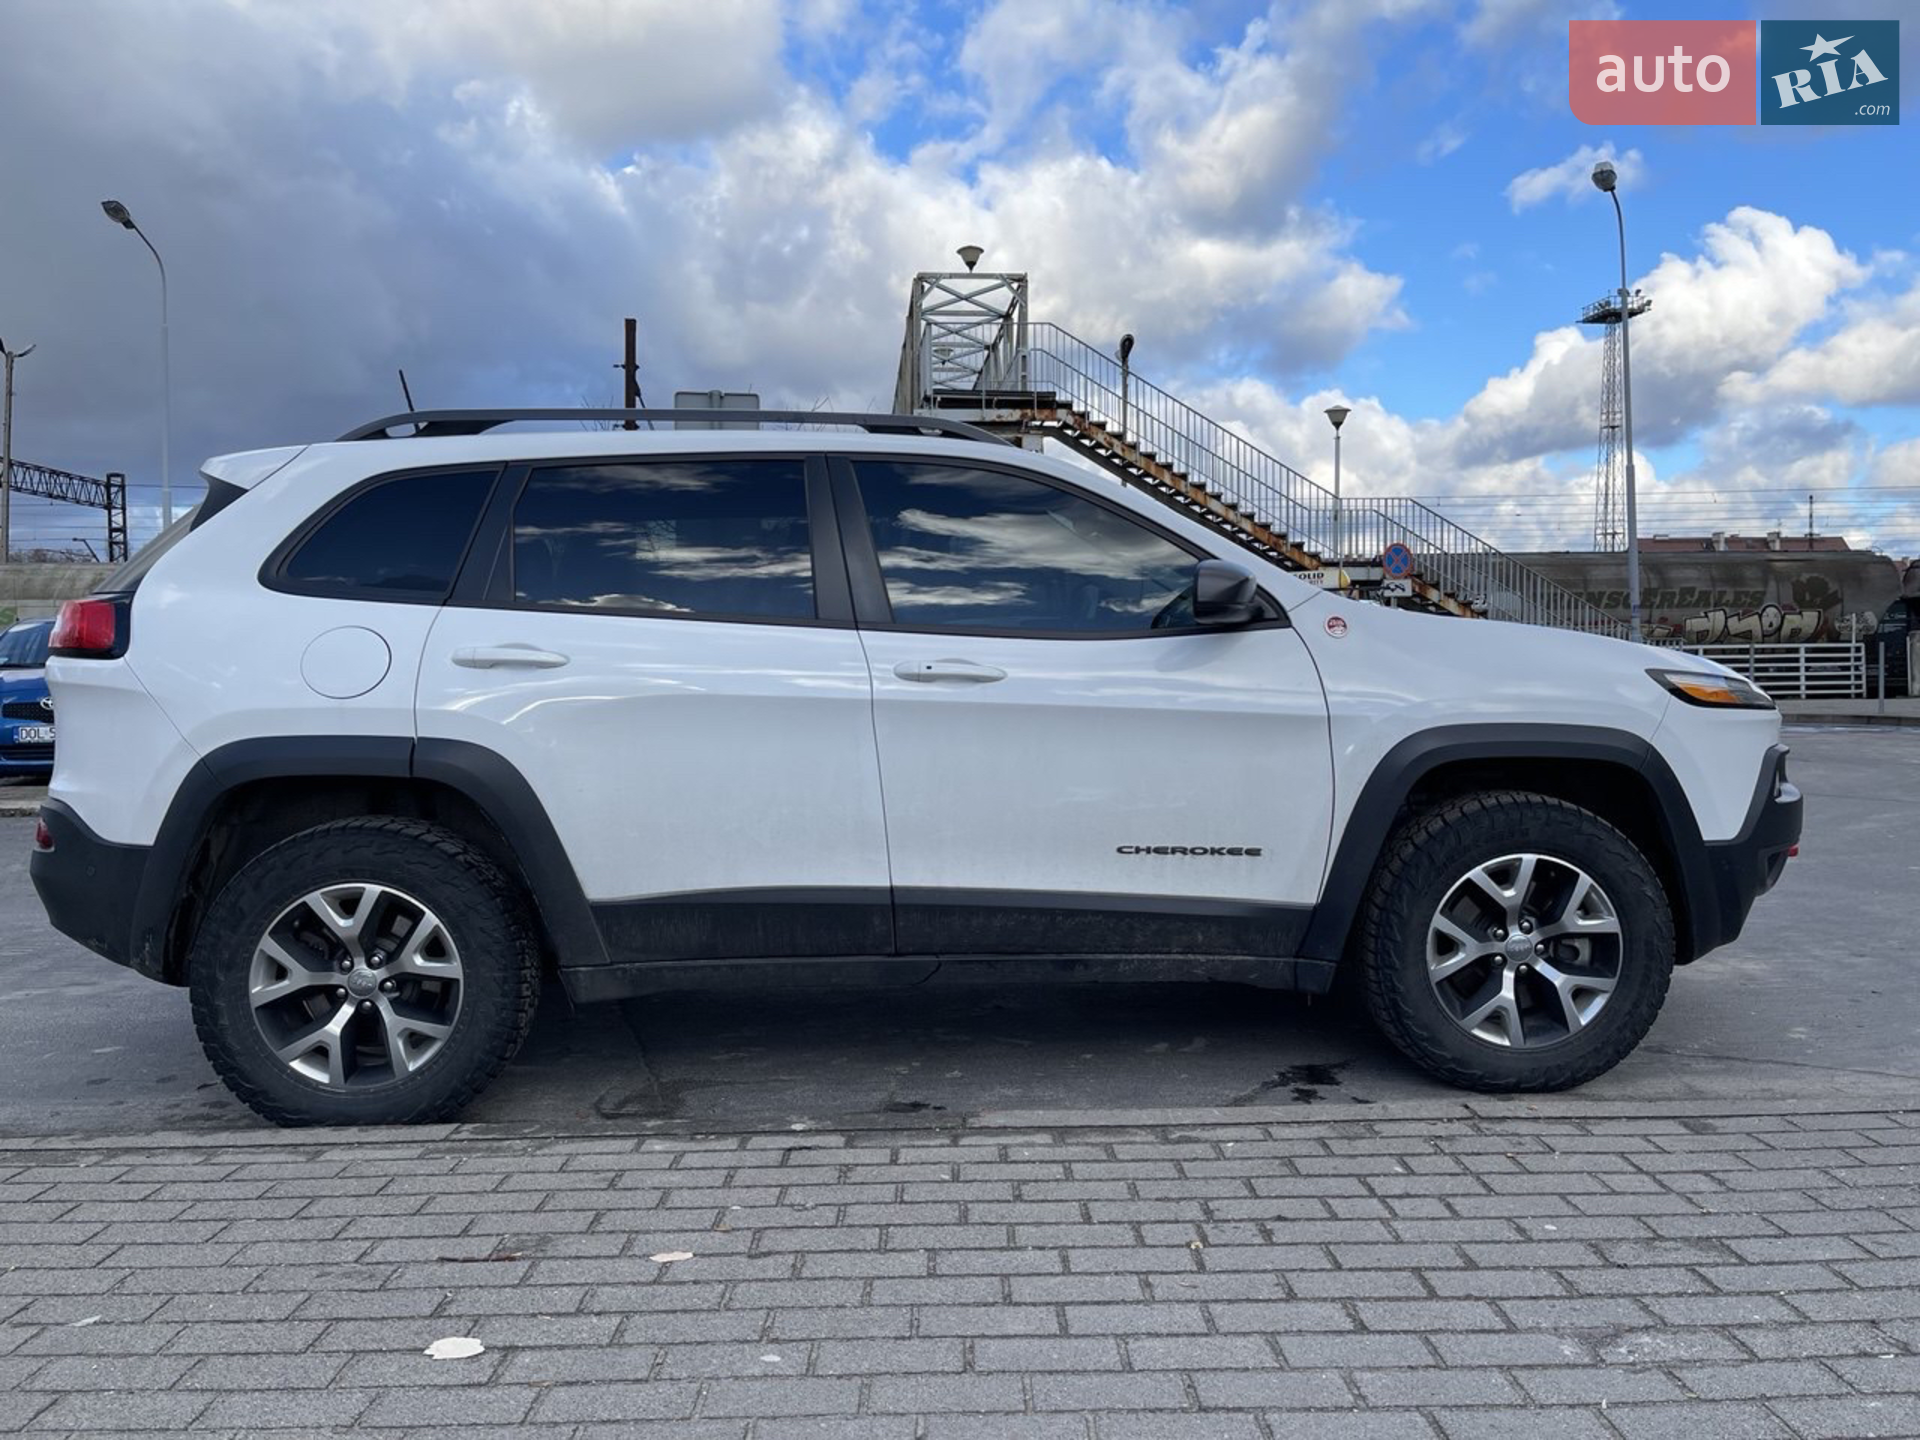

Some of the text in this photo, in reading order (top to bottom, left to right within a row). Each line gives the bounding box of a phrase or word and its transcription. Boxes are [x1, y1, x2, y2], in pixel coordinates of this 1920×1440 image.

[1293, 572, 1324, 580] OLID
[21, 728, 45, 740] DOL
[1116, 845, 1262, 857] CHEROKEE
